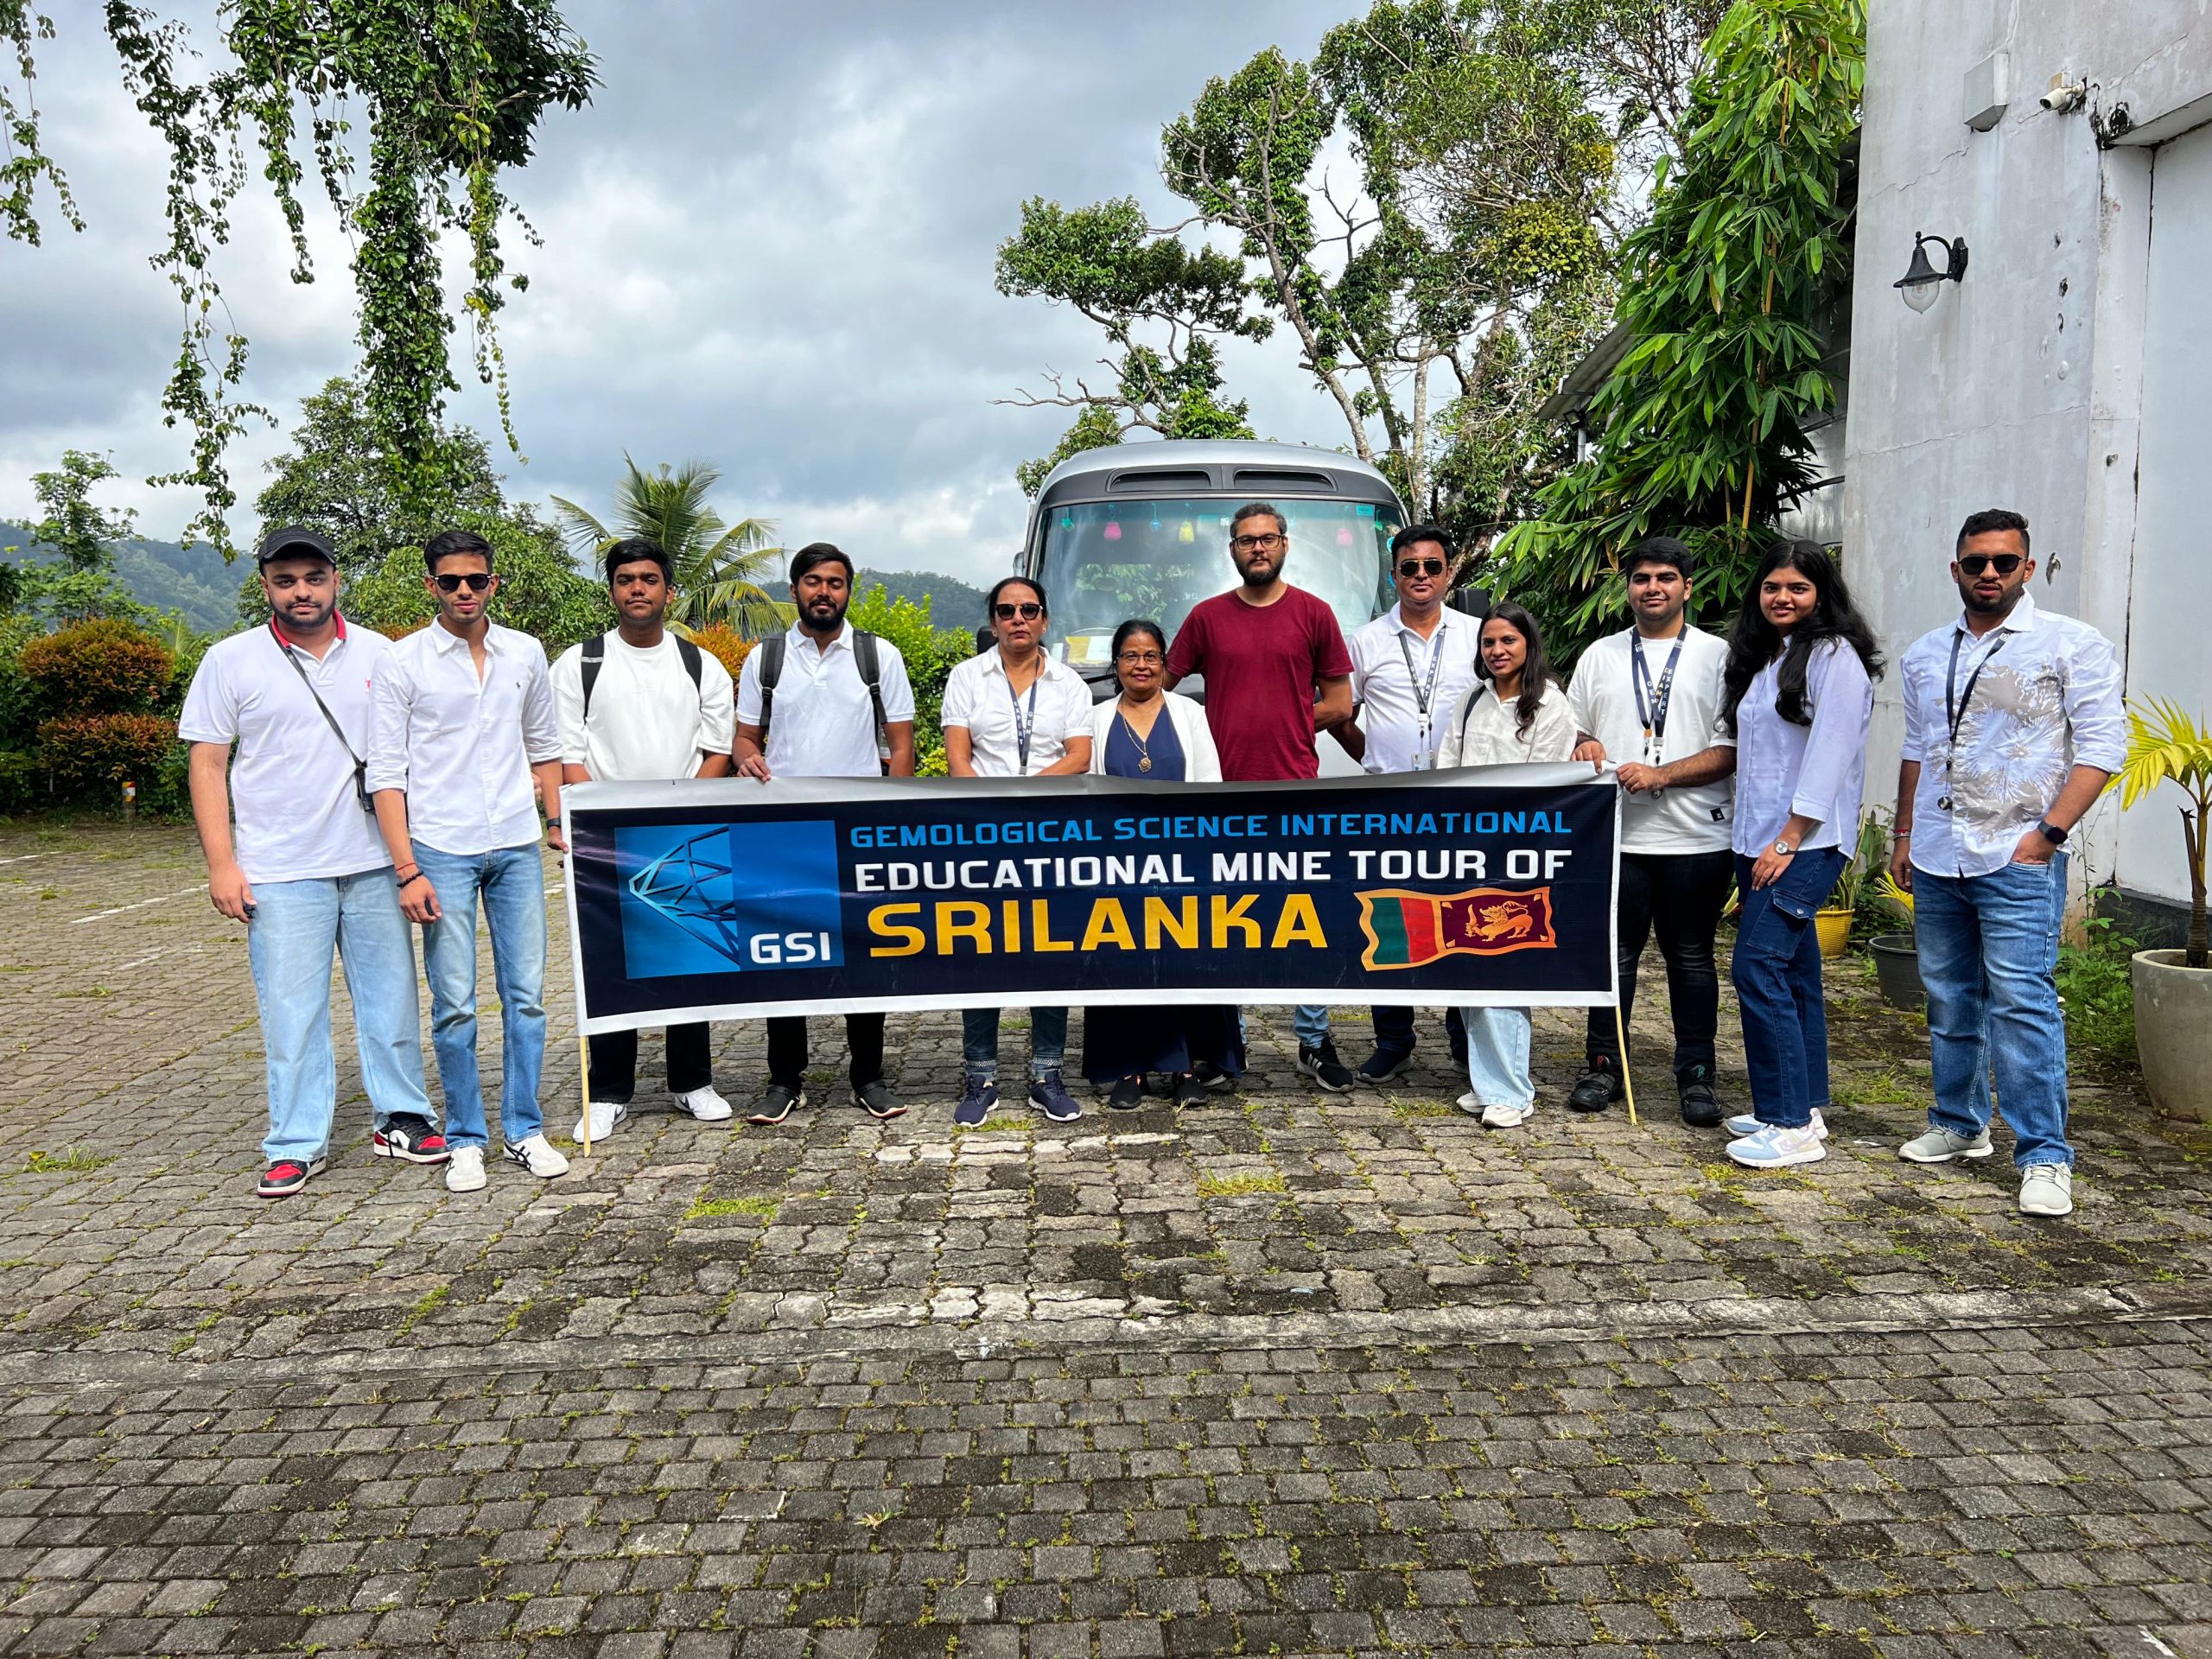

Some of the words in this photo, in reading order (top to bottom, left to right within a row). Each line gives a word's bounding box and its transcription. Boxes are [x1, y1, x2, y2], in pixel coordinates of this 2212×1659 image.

[1661, 668, 1674, 715] EXPERT
[850, 820, 1103, 848] GEMOLOGICAL
[1114, 816, 1268, 840] SCIENCE
[1281, 811, 1572, 836] INTERNATIONAL
[855, 854, 1195, 892] EDUCATIONAL
[1212, 851, 1332, 882] MINE
[1348, 849, 1486, 880] TOUR
[1506, 849, 1573, 880] OF
[868, 893, 1328, 957] SRILANKA
[750, 932, 830, 964] GSI
